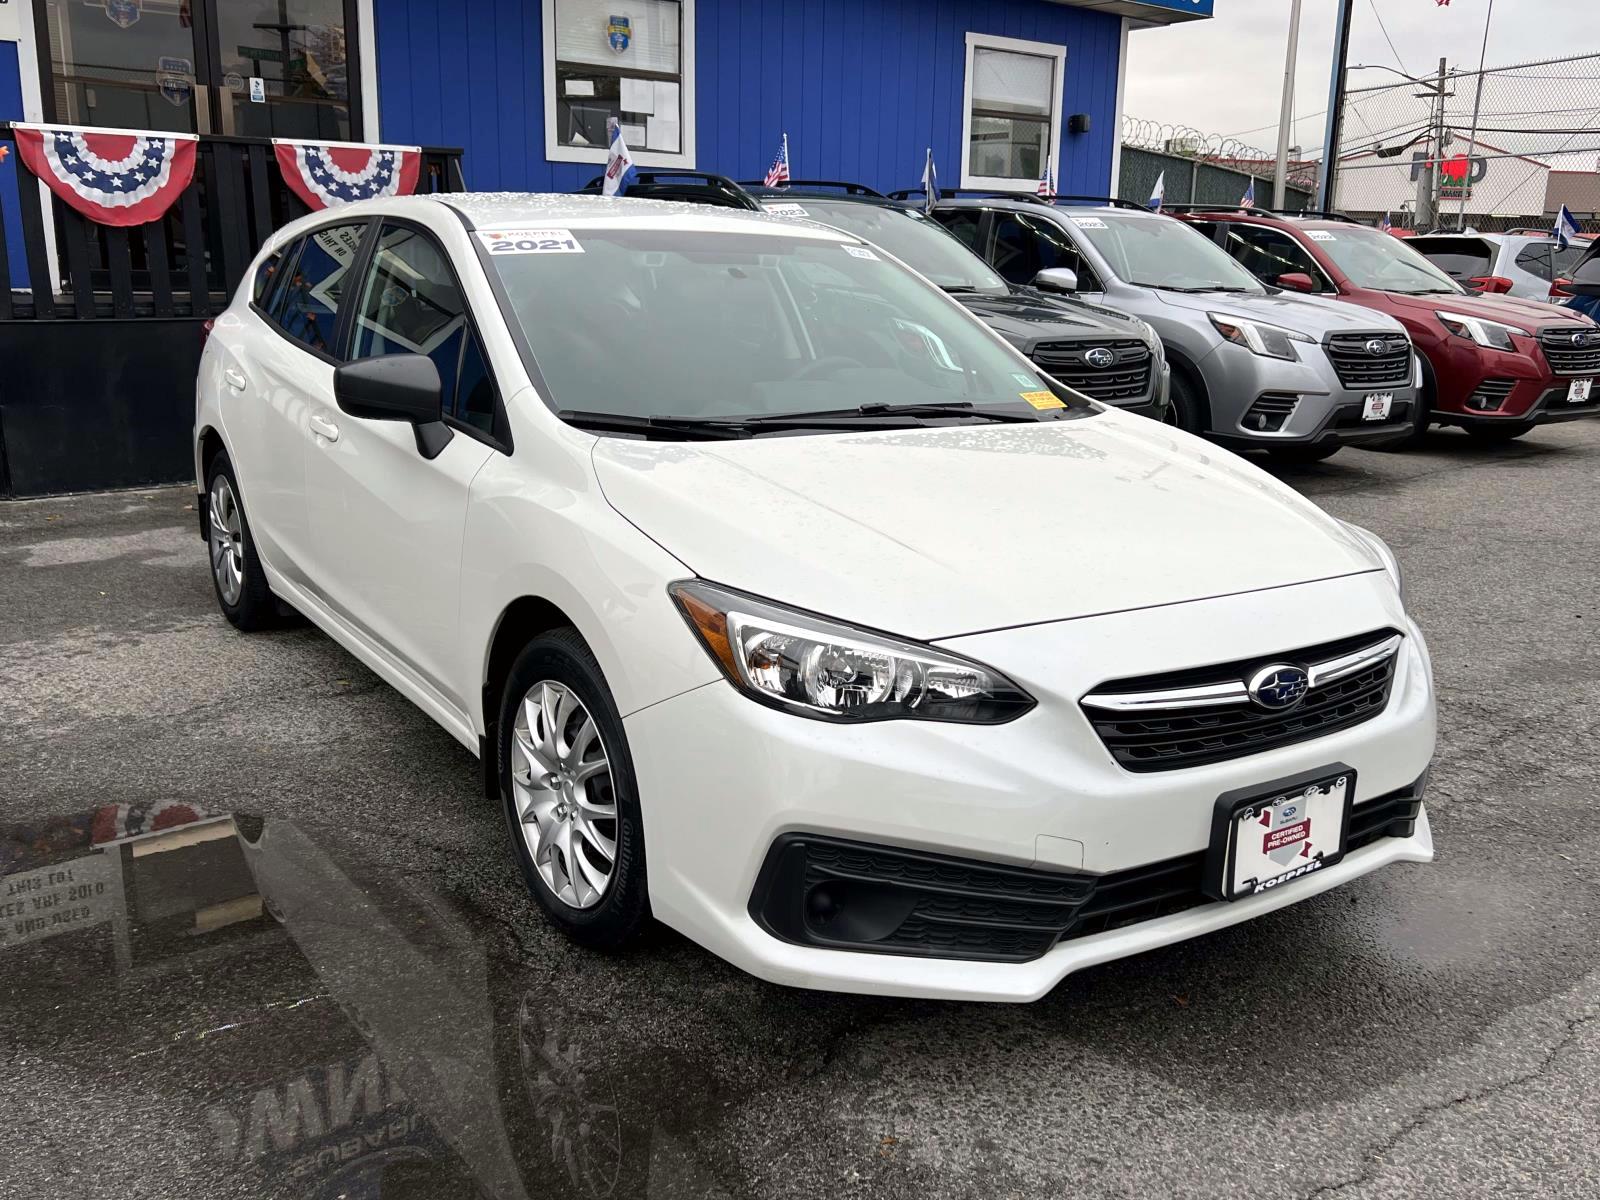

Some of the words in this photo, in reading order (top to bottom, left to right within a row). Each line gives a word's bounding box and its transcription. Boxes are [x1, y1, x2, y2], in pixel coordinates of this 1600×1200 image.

[1410, 152, 1487, 183] FD
[491, 240, 575, 251] 2021
[1267, 831, 1306, 848] PRE-OWNED
[1271, 824, 1304, 840] CERTIFIED
[1254, 860, 1322, 893] KOEPPEL
